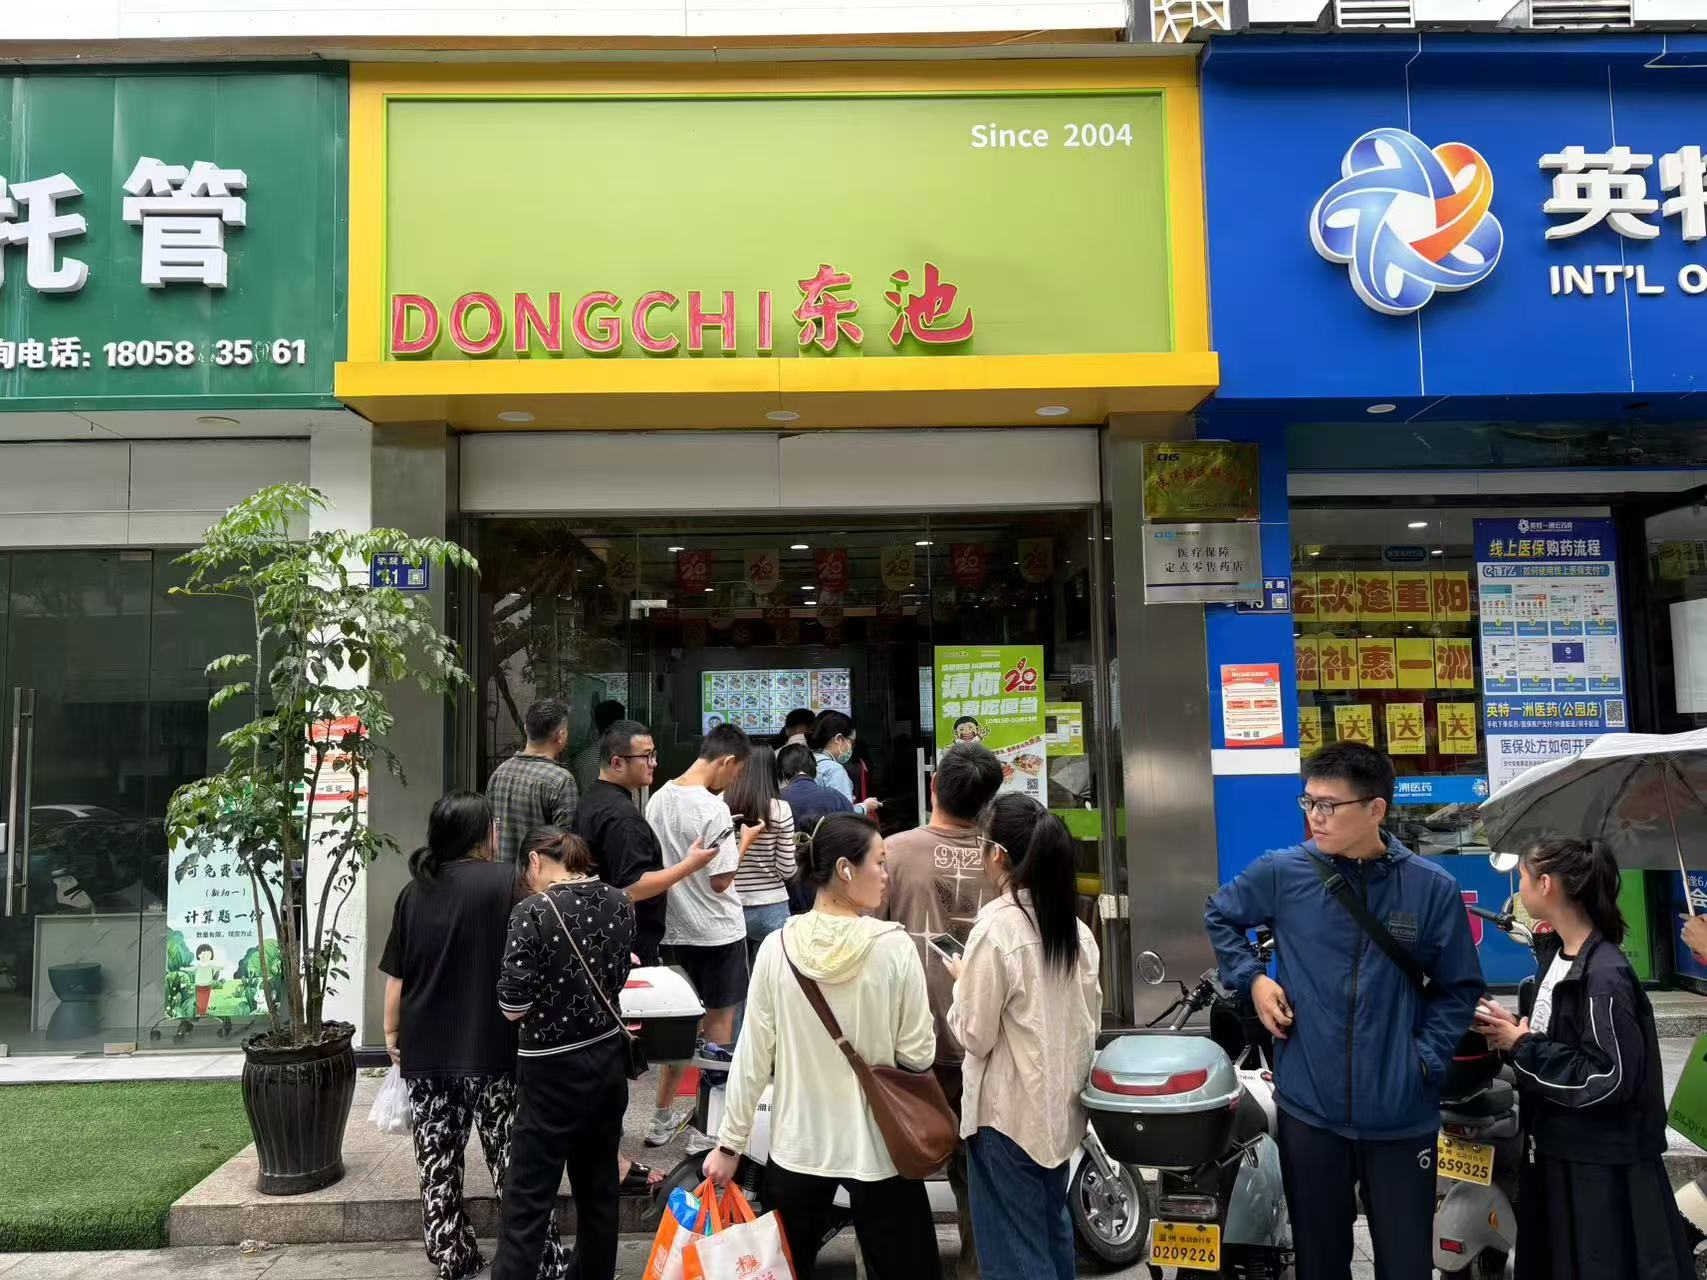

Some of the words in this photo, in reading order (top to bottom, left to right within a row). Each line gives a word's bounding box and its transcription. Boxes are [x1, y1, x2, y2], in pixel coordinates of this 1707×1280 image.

[971, 122, 1048, 149] Since
[1063, 123, 1134, 149] 2004
[0, 156, 248, 293] 托管
[1550, 264, 1665, 295] INT'L
[391, 290, 773, 355] DONGCHI
[792, 262, 974, 351] 东池
[103, 340, 196, 368] 18058
[215, 339, 252, 365] 35
[272, 338, 306, 365] 61
[377, 556, 423, 566] 学院西
[1177, 546, 1230, 559] 医疗保障
[1489, 539, 1601, 557] 线上医保购药流程
[1164, 560, 1244, 574] 定点零售药店
[1486, 701, 1603, 718] 英特一洲医药(公园店)
[1344, 715, 1372, 743] 送
[1396, 713, 1424, 741] 送
[1447, 713, 1475, 741] 送
[934, 844, 984, 870] 912
[1153, 1245, 1216, 1263] 0209226
